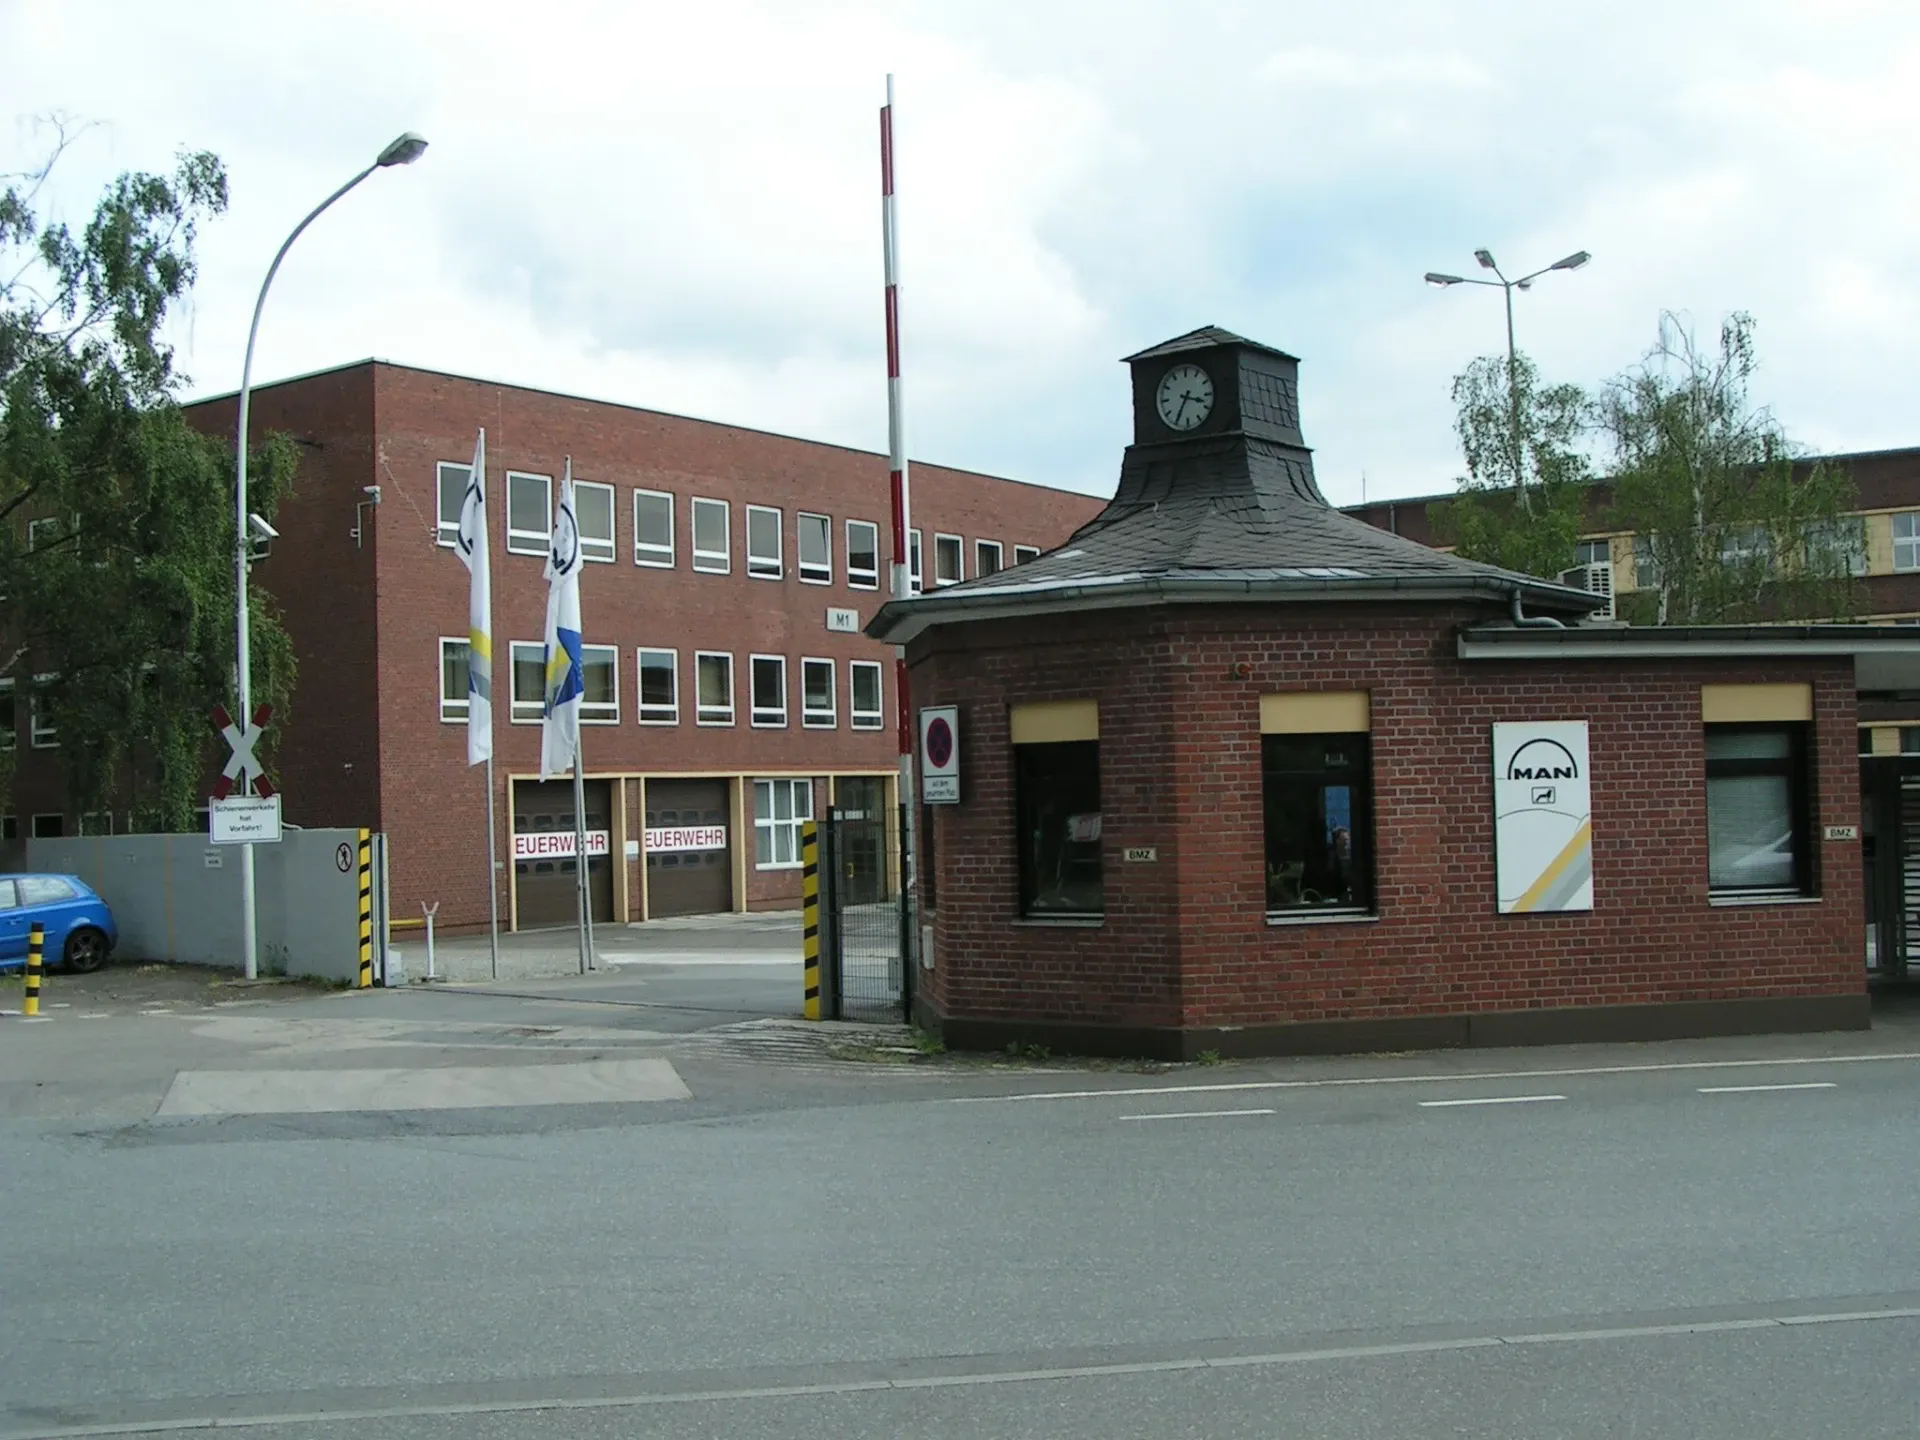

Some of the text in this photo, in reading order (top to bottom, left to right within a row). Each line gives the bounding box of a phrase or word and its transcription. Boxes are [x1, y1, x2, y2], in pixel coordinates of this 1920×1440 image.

[836, 612, 850, 627] M1
[1513, 767, 1572, 780] MAN
[1129, 850, 1150, 859] BMZ
